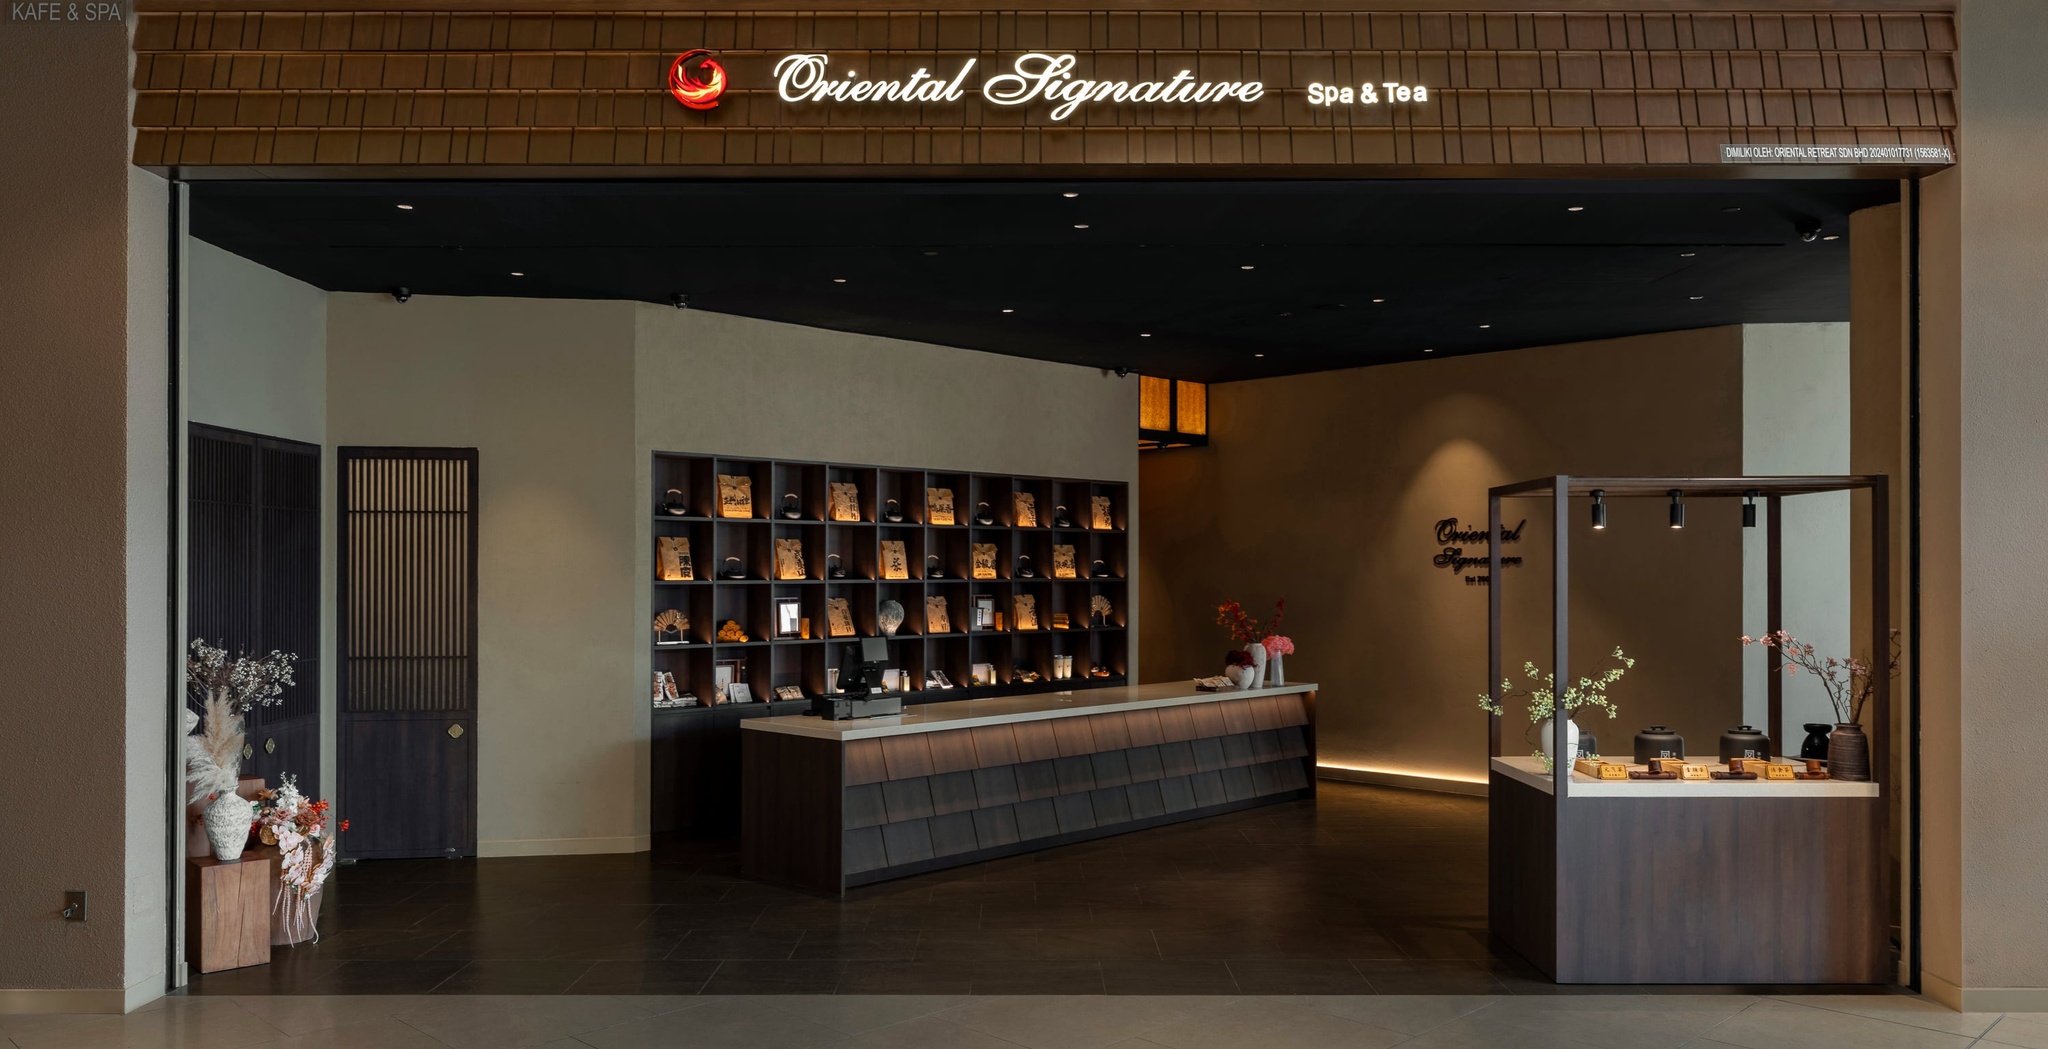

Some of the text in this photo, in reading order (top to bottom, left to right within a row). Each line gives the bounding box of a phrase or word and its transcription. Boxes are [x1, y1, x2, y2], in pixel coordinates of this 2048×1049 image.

[12, 3, 121, 21] KAFE & SPA
[773, 52, 1428, 122] Oriental Signature Spa & Tea
[1726, 147, 1752, 158] DIMILIKI
[1753, 147, 1773, 158] OLEH:
[1775, 147, 1807, 159] ORIENTAL
[1808, 147, 1837, 159] RETREAT
[1838, 147, 1853, 159] SDN
[1854, 147, 1869, 159] BHD
[1434, 517, 1527, 544] Orienal
[1477, 575, 1490, 583] 200
